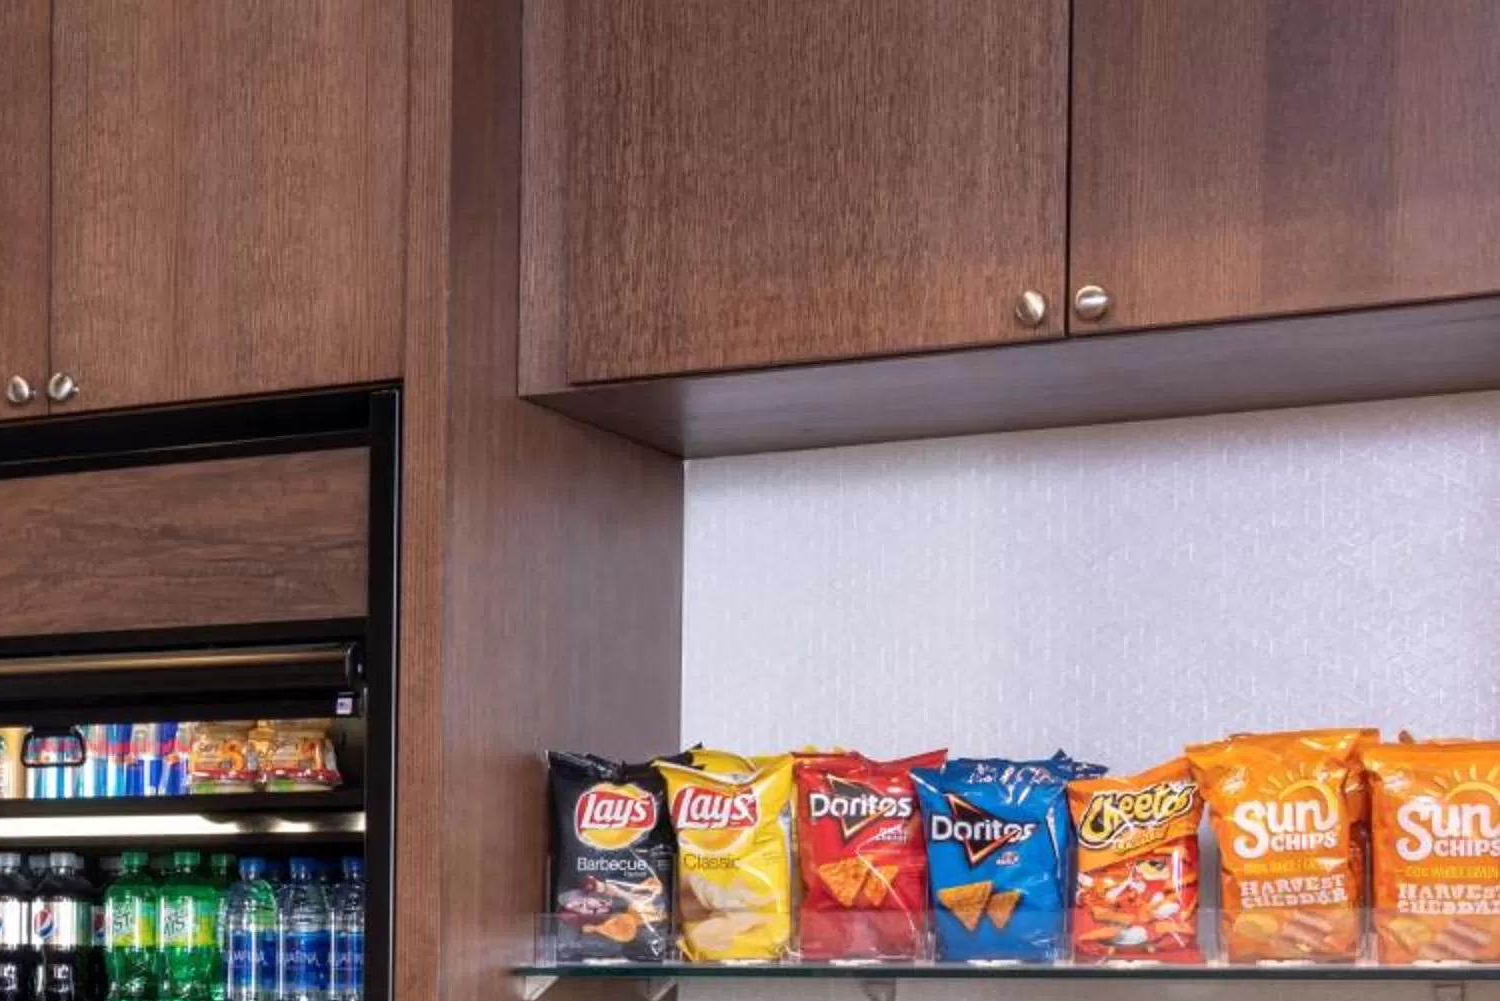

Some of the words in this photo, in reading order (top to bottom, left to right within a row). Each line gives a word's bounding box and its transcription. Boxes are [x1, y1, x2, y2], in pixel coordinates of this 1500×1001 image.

[809, 793, 913, 818] Doritos
[931, 815, 1038, 841] Doritos
[1233, 799, 1338, 859] Sun
[1396, 795, 1500, 861] Sun
[1271, 832, 1338, 852] CHIPS
[576, 857, 648, 871] Barbecue
[1241, 874, 1346, 896] HARVEST
